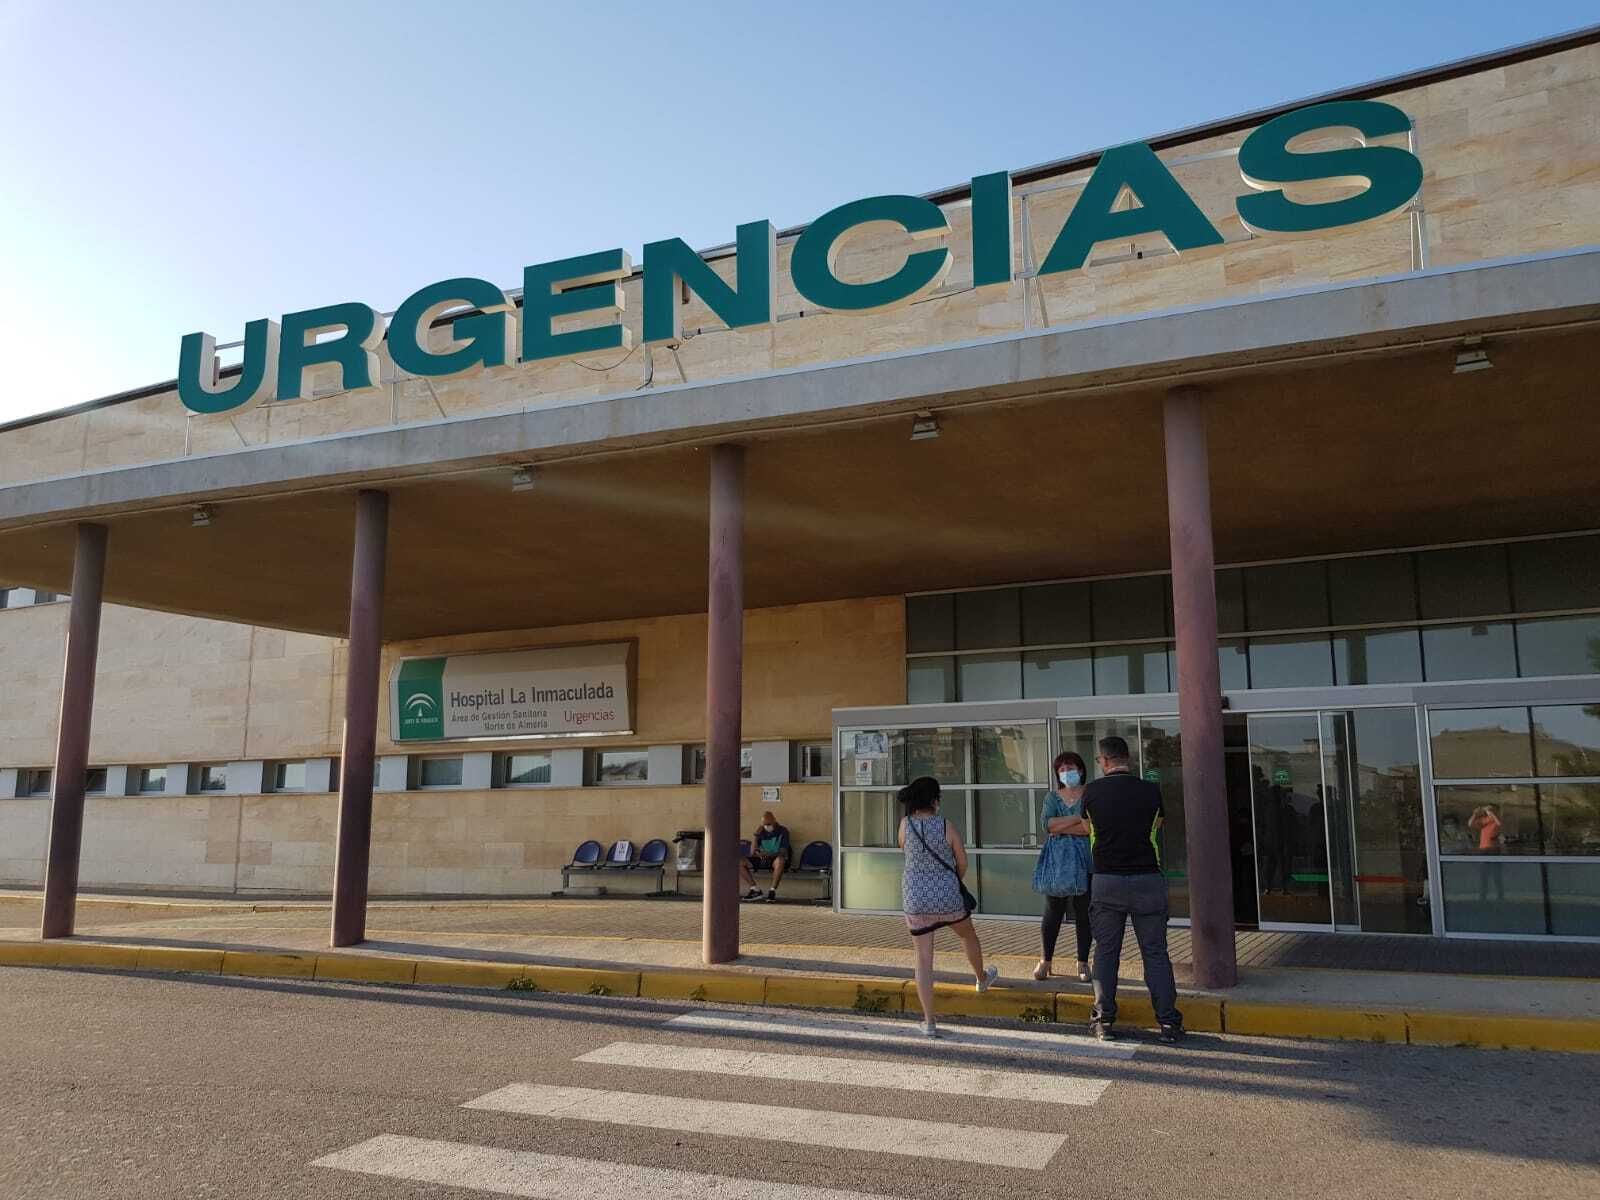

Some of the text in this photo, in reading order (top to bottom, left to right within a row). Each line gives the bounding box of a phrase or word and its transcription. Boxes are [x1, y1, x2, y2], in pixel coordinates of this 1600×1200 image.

[178, 100, 1424, 414] URGENCIAS
[450, 681, 615, 709] Hospital La Inmaculada
[482, 711, 510, 721] Gestión
[513, 709, 548, 719] Sanitaria
[563, 709, 616, 725] Urgencias
[484, 722, 505, 731] Norte
[506, 722, 516, 730] de
